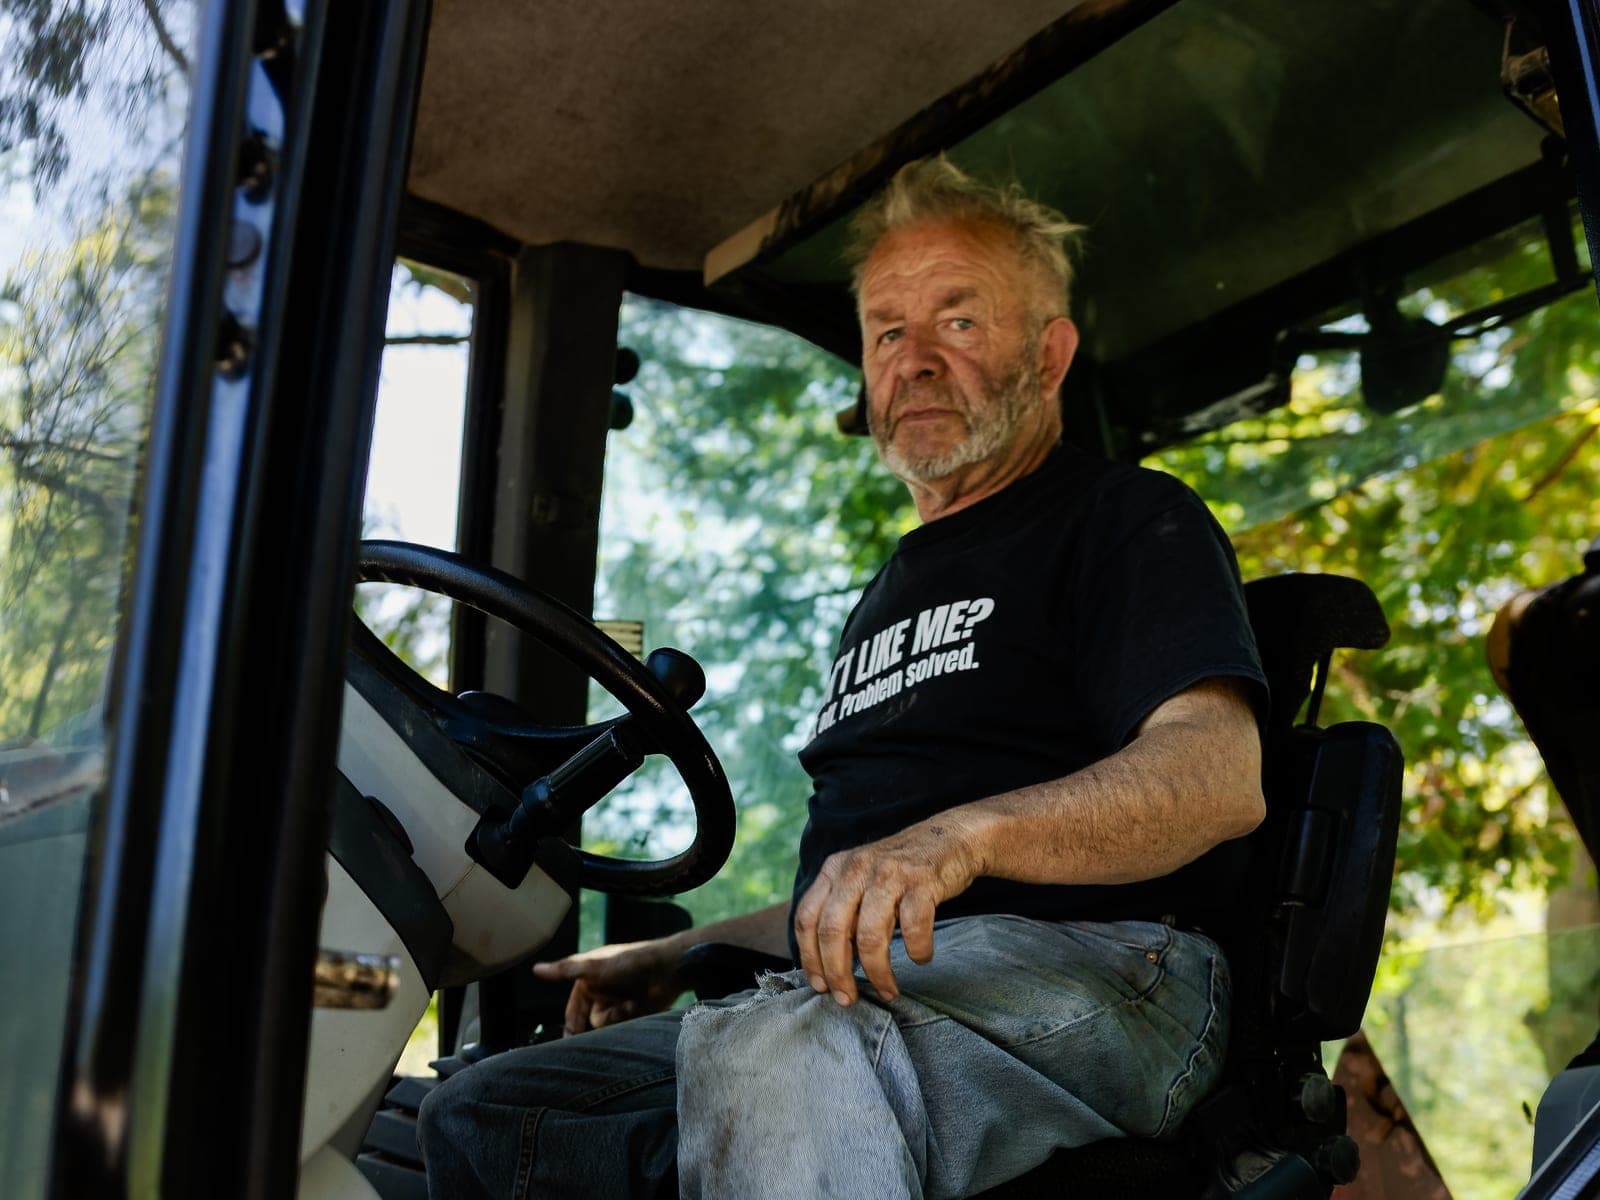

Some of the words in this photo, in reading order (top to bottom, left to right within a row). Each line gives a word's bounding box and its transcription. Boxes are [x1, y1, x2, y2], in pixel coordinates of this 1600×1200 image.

[839, 669, 904, 721] Problem
[904, 641, 980, 688] solved.
[854, 617, 912, 686] LIKE
[910, 597, 995, 656] ME?
